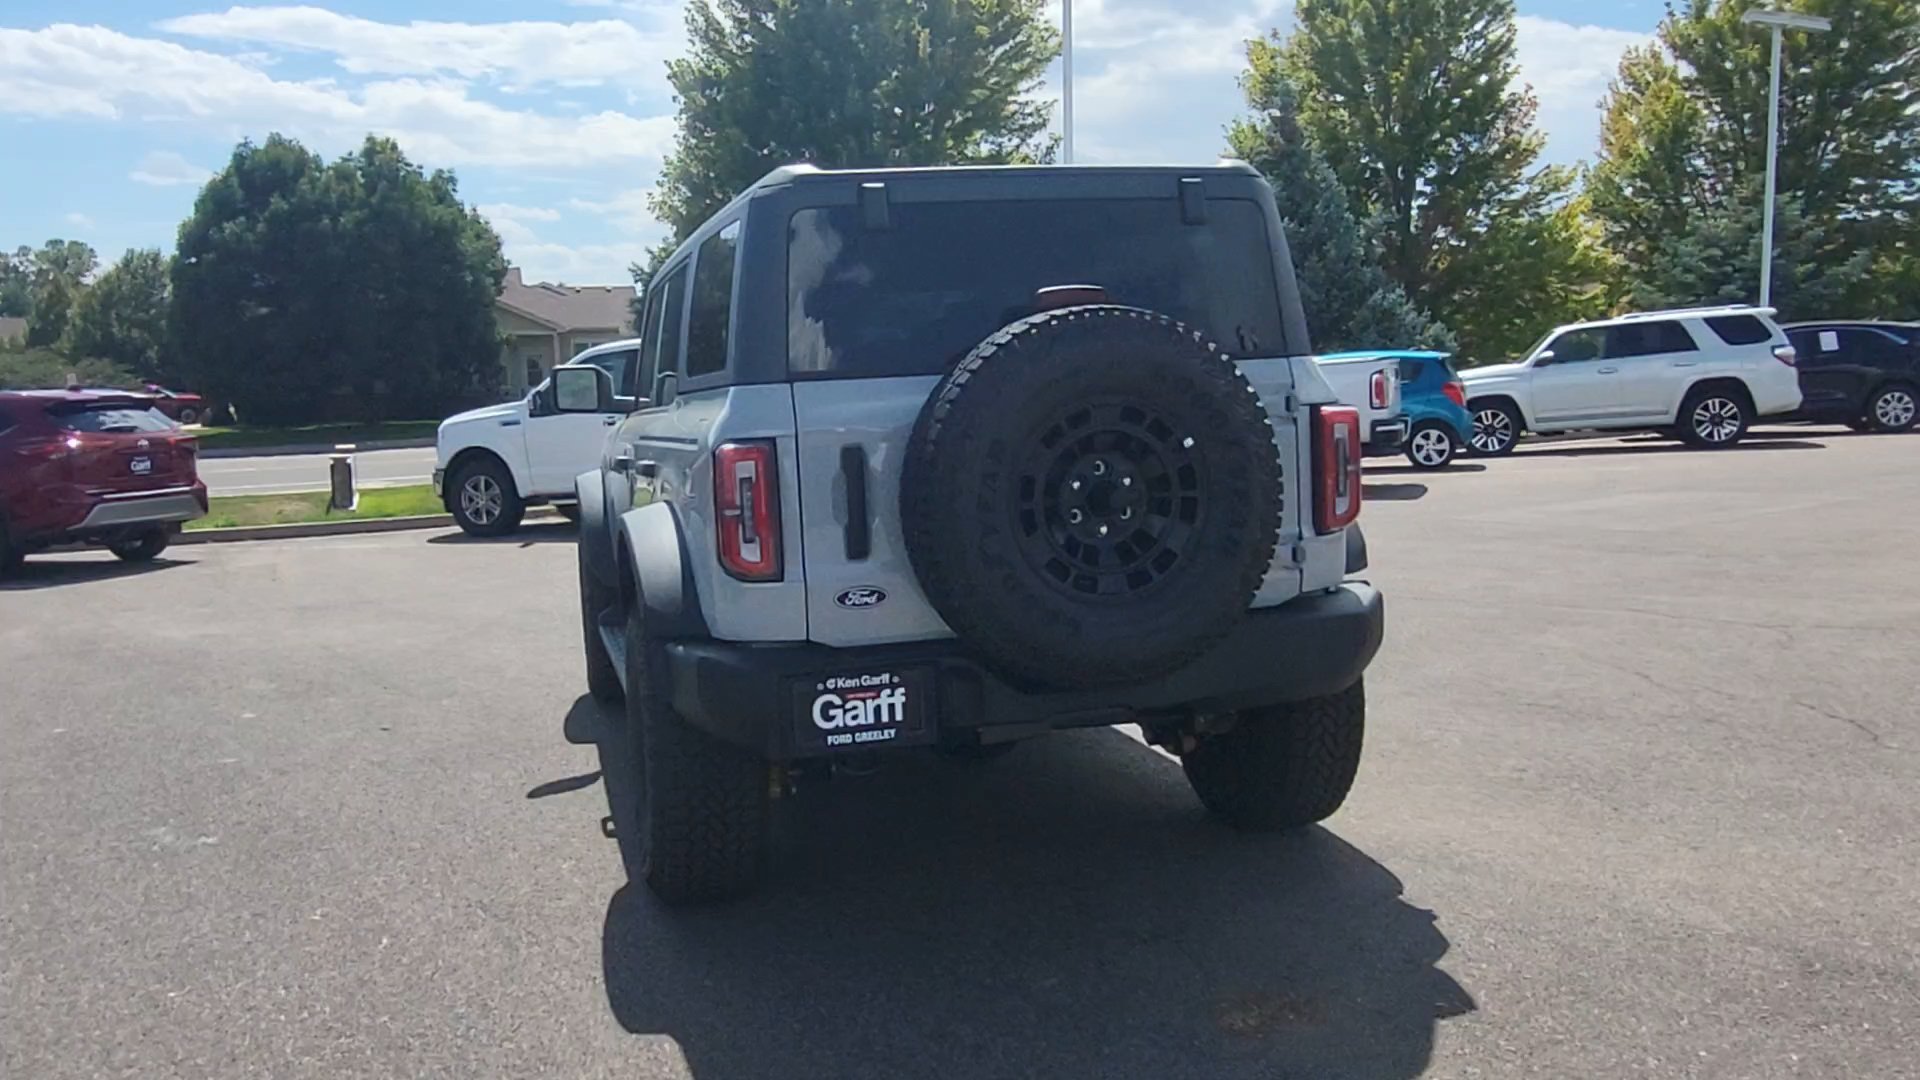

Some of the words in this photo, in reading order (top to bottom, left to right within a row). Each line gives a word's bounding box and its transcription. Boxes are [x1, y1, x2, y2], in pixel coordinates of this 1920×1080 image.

[845, 591, 880, 605] Ford
[837, 677, 860, 689] Ken
[861, 673, 890, 687] Garff
[812, 687, 906, 729] Garff
[827, 733, 853, 746] FORD
[855, 729, 897, 743] GREELEY
